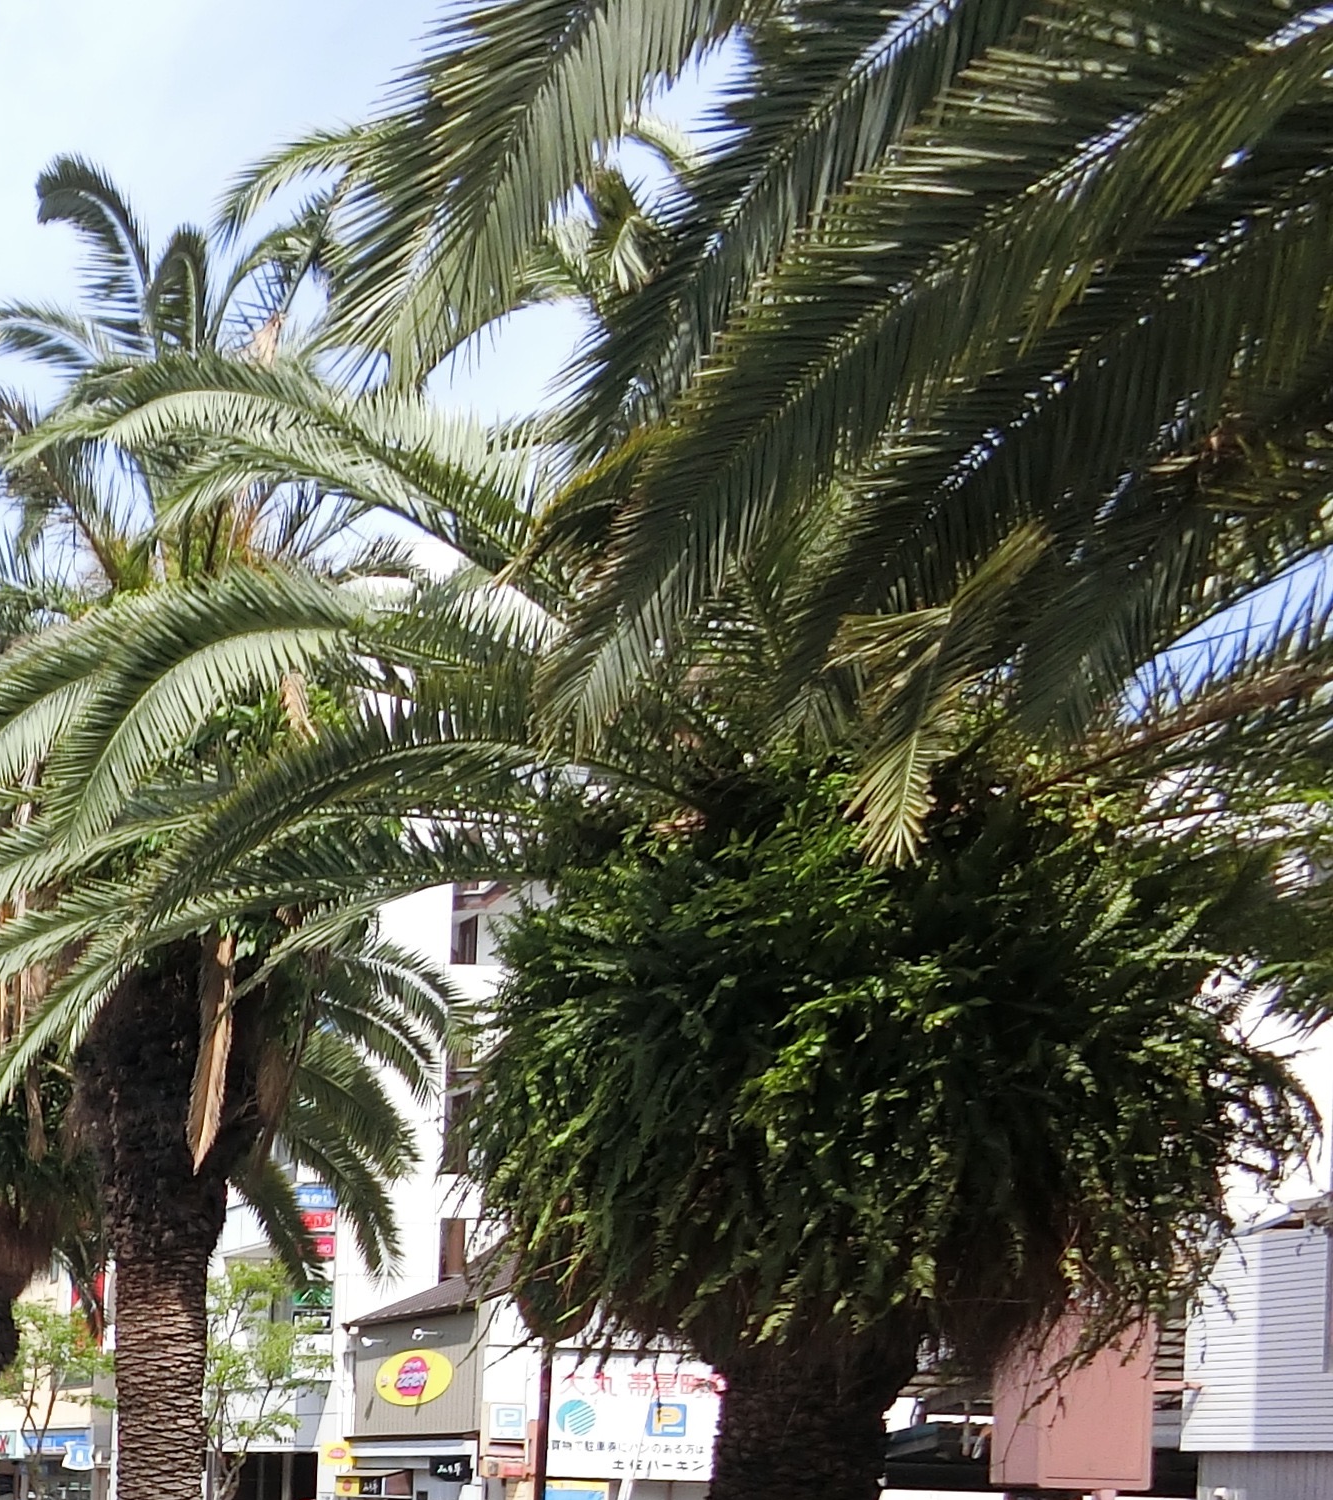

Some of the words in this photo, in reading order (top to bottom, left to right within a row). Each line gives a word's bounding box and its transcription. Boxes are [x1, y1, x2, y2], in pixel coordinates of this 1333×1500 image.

[560, 1371, 617, 1397] 大丸
[612, 1459, 714, 1472] 土佐パーキン
